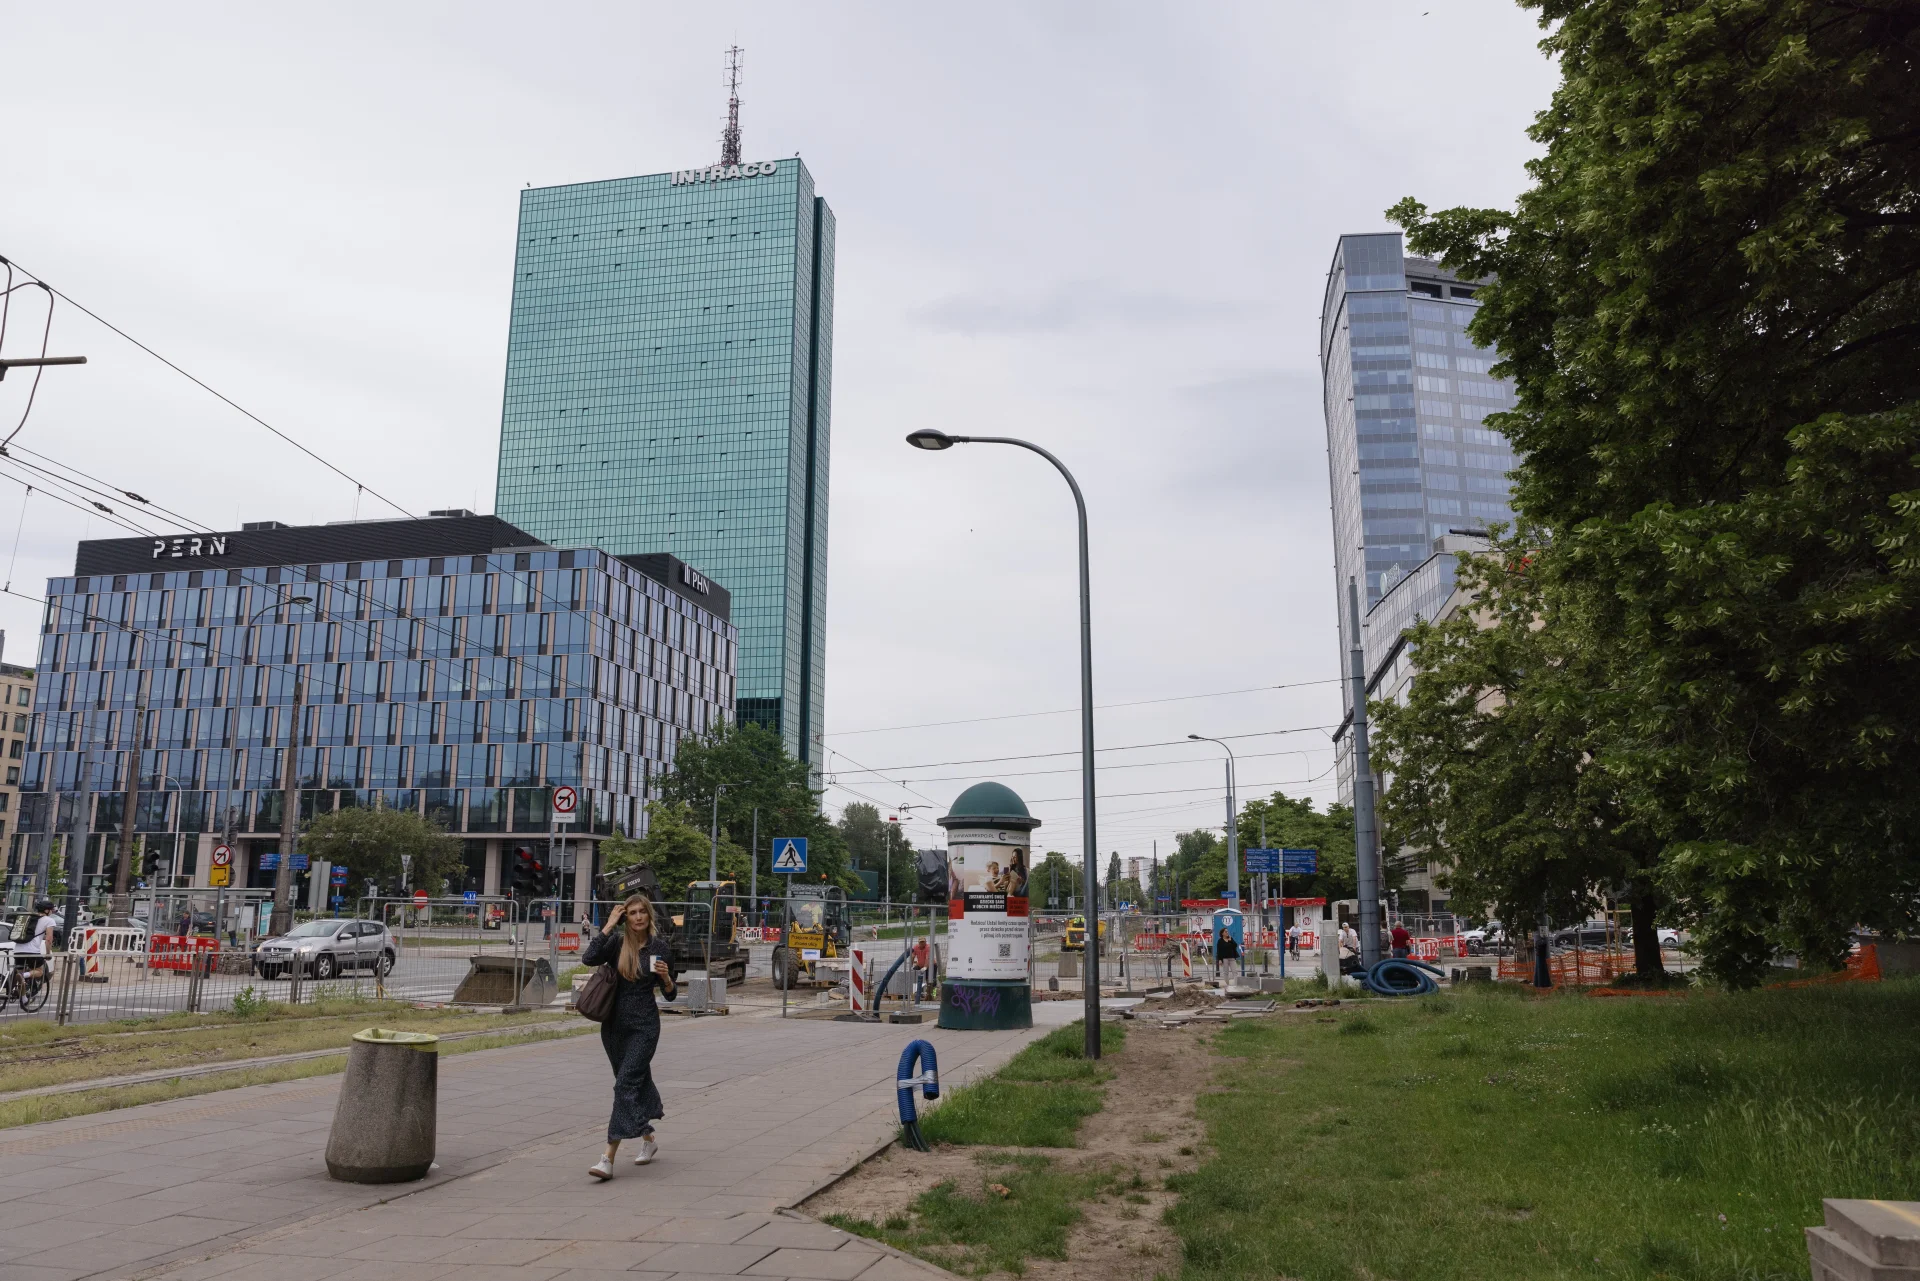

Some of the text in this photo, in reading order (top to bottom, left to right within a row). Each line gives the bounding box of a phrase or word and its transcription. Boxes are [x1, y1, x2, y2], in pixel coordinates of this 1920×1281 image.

[671, 161, 777, 186] INTRACO
[152, 536, 226, 559] PERN
[692, 571, 709, 596] PHN
[627, 878, 641, 887] VOLVO
